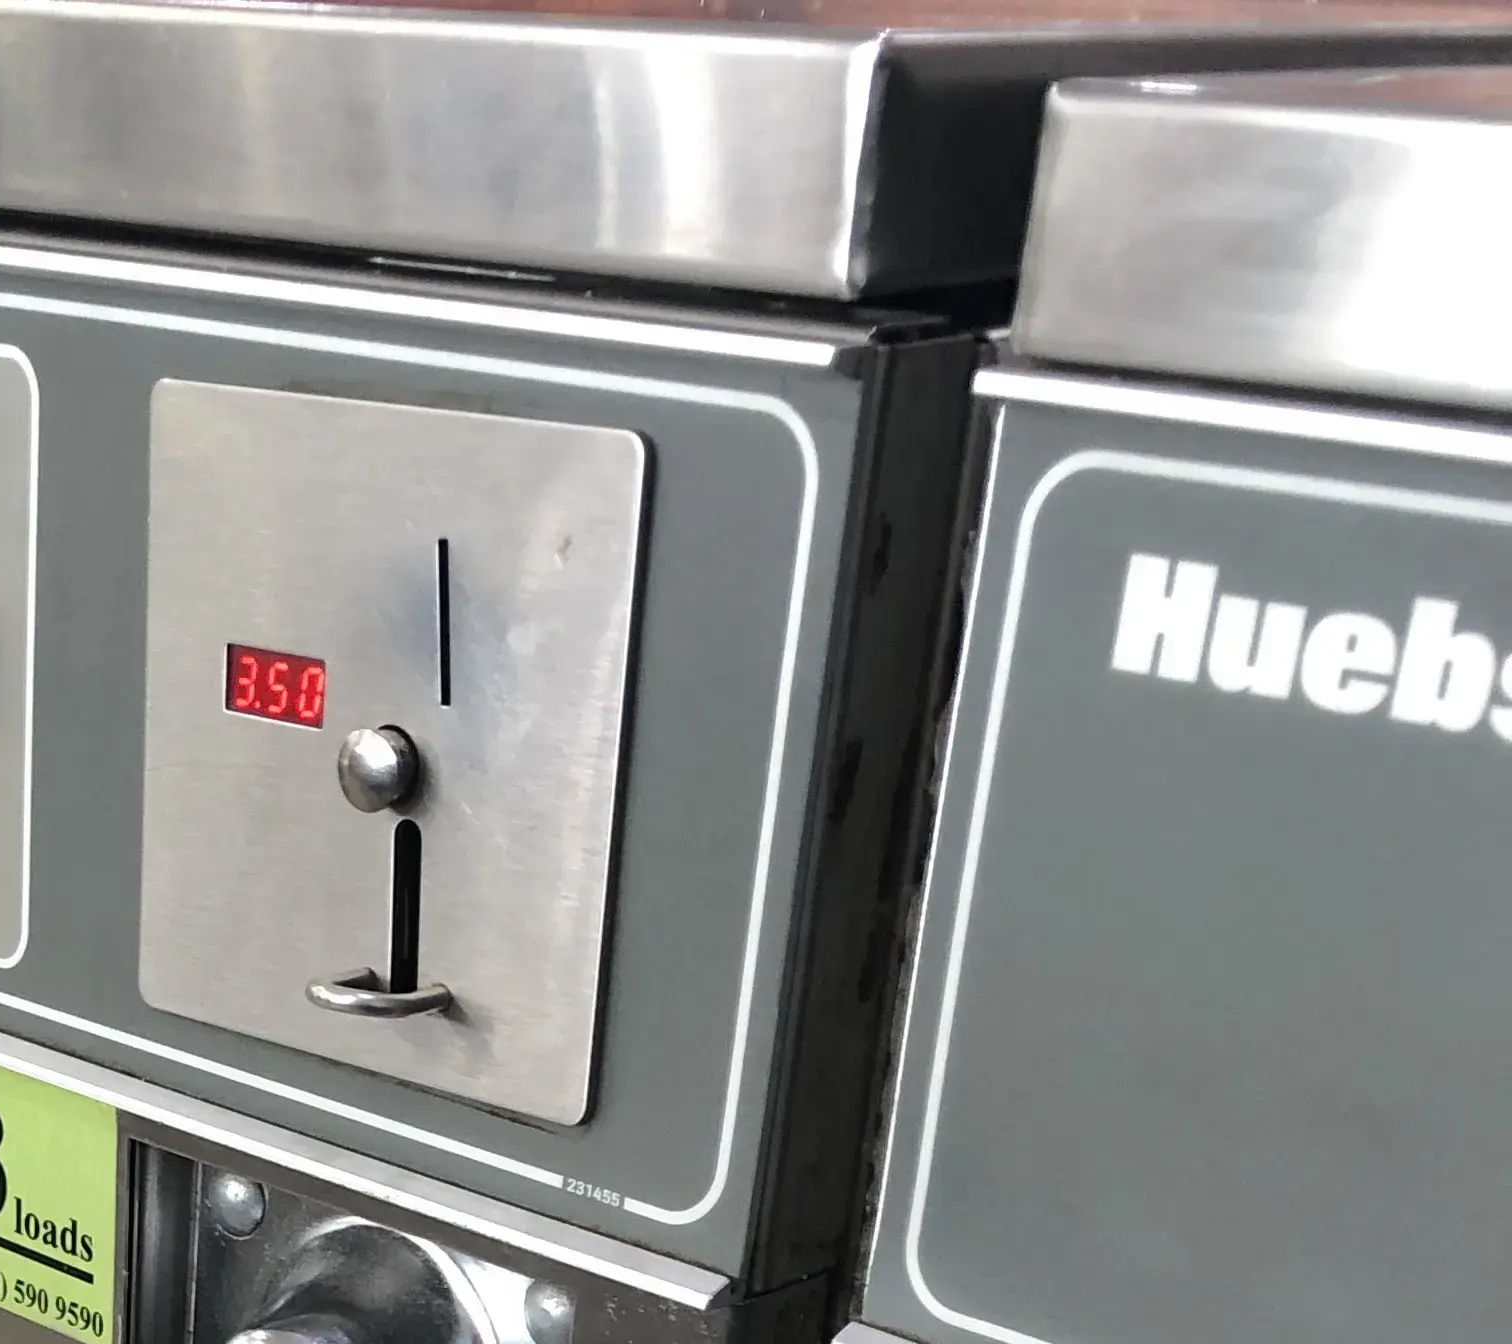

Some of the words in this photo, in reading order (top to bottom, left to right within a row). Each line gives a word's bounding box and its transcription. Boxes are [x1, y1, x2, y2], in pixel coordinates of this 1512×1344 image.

[236, 655, 325, 718] 3.50
[567, 1178, 620, 1207] 231455
[13, 1196, 94, 1263] loads
[13, 1279, 49, 1314] 590
[55, 1294, 104, 1338] 9590
